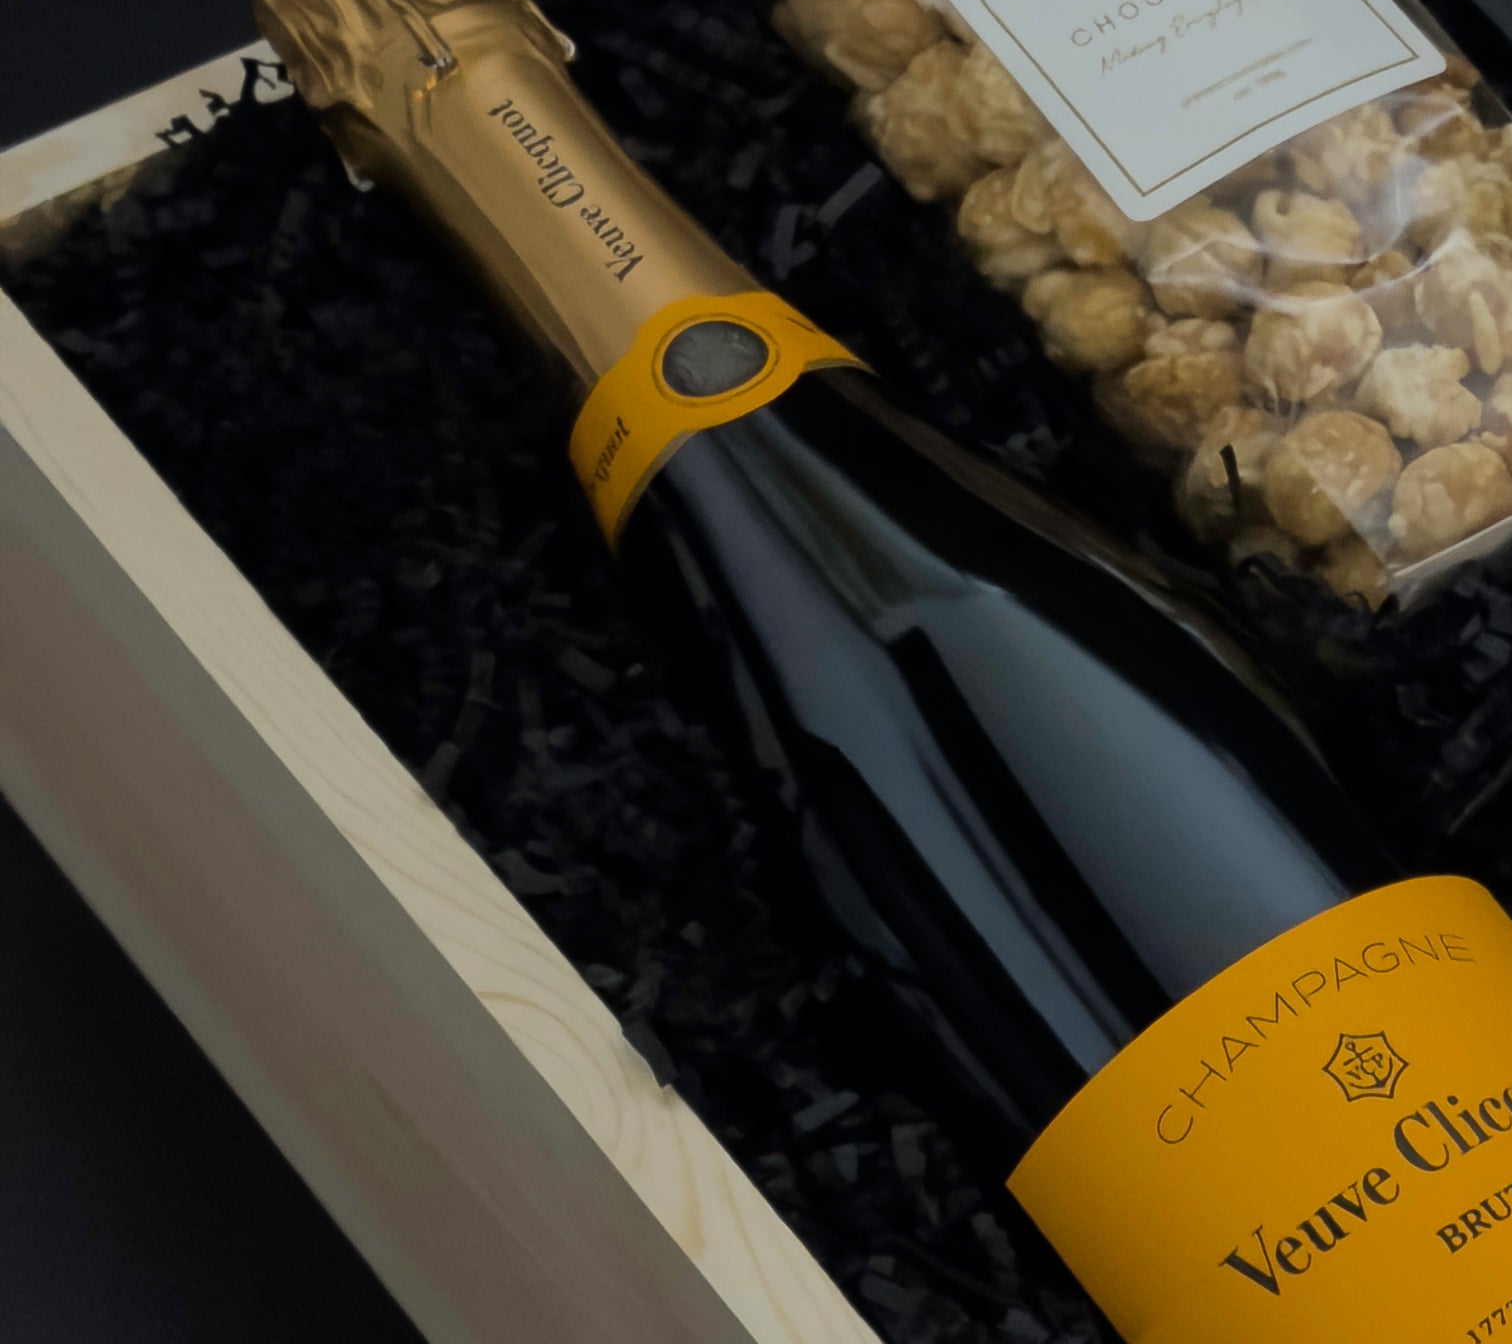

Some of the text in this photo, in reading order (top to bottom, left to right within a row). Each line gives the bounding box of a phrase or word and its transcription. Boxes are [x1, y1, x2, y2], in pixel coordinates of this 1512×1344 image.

[487, 97, 646, 284] Veuve Clicquot
[1154, 932, 1477, 1146] CHAMPAGNE
[1219, 1165, 1401, 1298] Veuve
